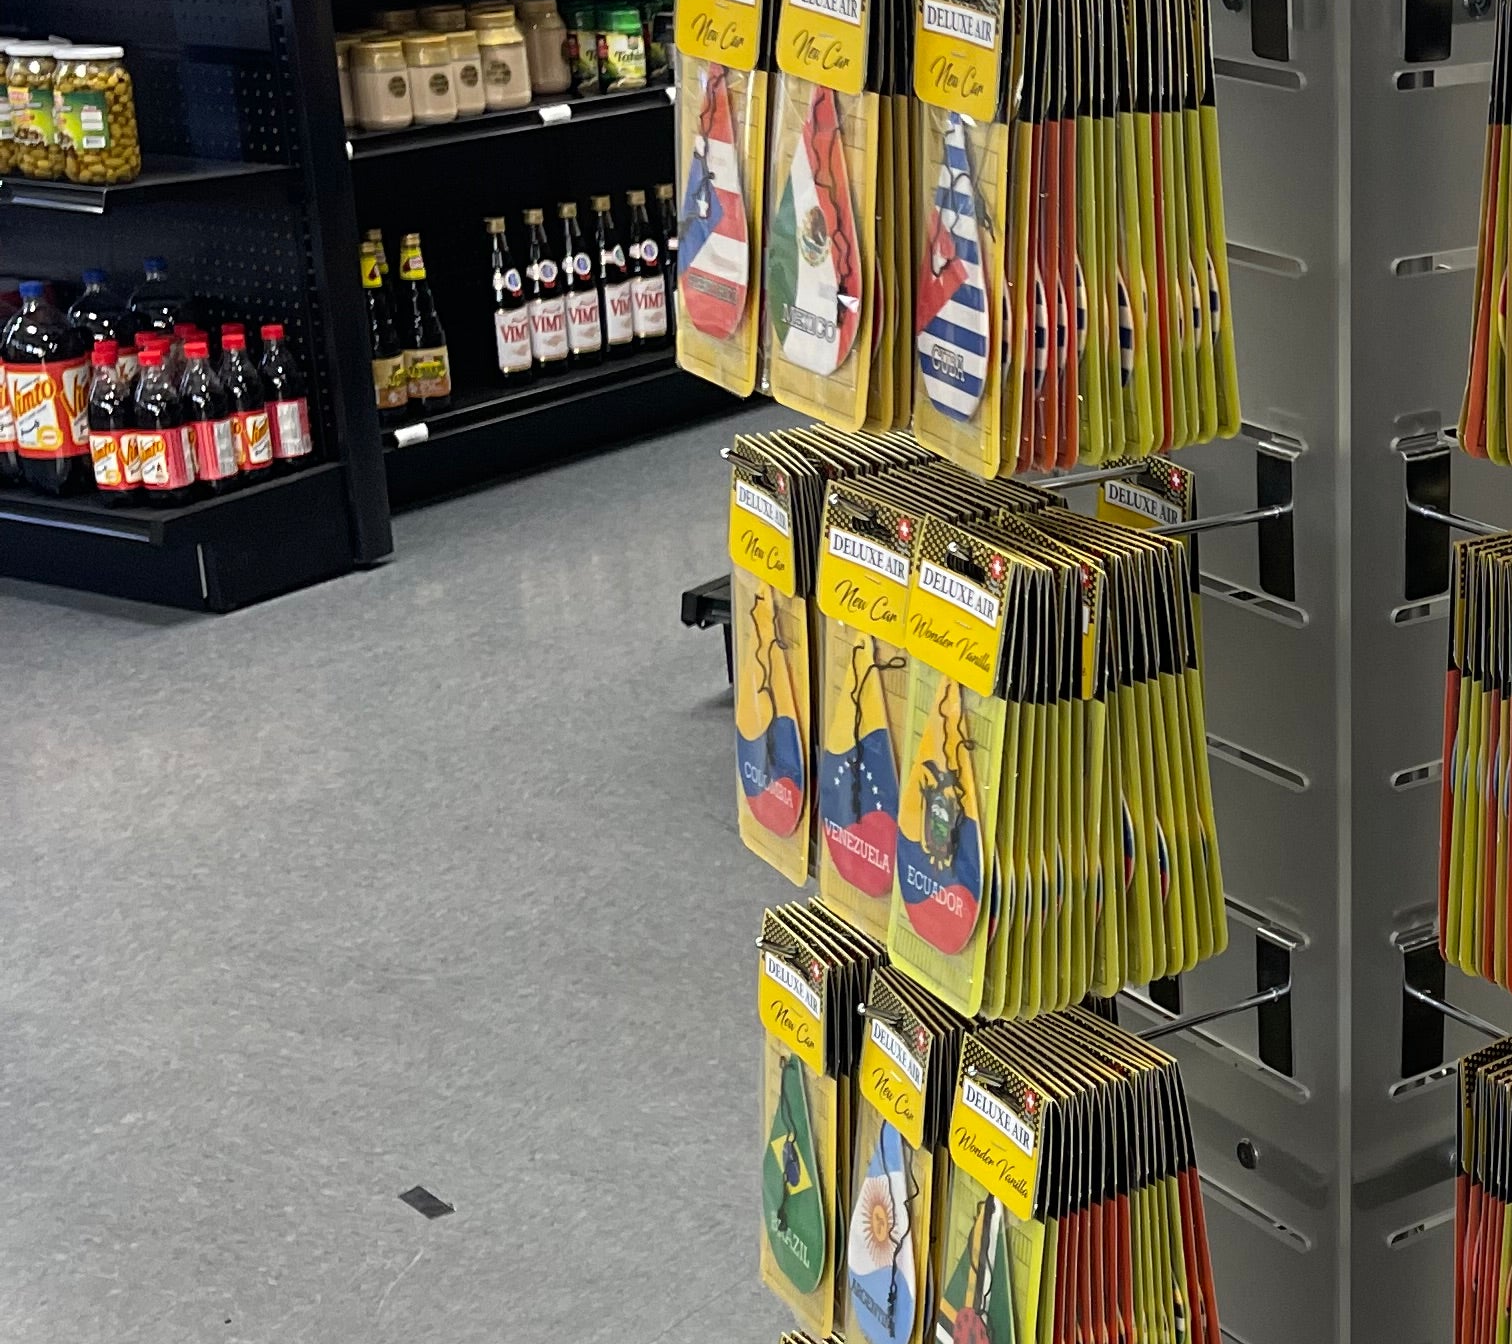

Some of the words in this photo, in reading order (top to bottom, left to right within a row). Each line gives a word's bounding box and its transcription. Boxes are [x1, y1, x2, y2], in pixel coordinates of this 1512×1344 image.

[926, 5, 973, 38] DELUXE
[974, 18, 993, 44] AIR
[780, 303, 837, 345] MEXICO
[930, 342, 966, 384] CUBA
[922, 567, 974, 609] DELUXE
[975, 591, 996, 622] AIR
[823, 817, 891, 875] VENEZUELA
[906, 864, 965, 918] ECUADOR
